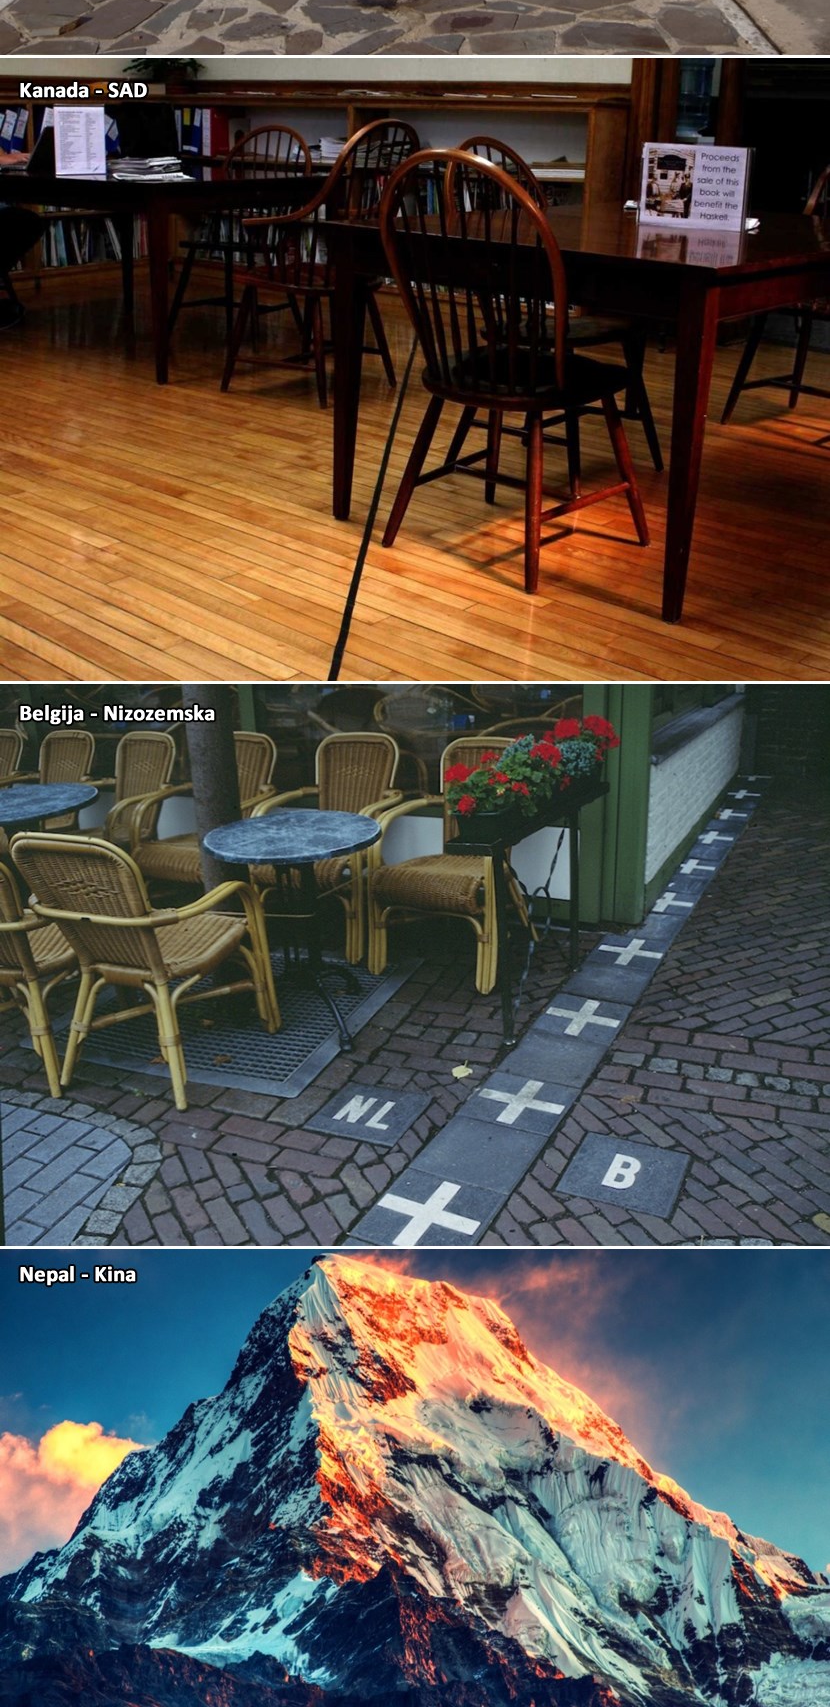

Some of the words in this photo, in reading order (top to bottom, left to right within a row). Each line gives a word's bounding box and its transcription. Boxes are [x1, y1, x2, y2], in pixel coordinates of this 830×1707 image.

[700, 152, 740, 163] Proceeds
[702, 164, 721, 173] from
[722, 166, 737, 174] the
[697, 176, 714, 185] sale
[715, 177, 724, 185] of
[725, 178, 740, 186] this
[699, 188, 721, 197] book
[722, 190, 736, 198] will
[693, 200, 723, 208] benefit
[724, 202, 739, 210] the
[331, 1094, 396, 1131] NL
[600, 1152, 642, 1190] B
